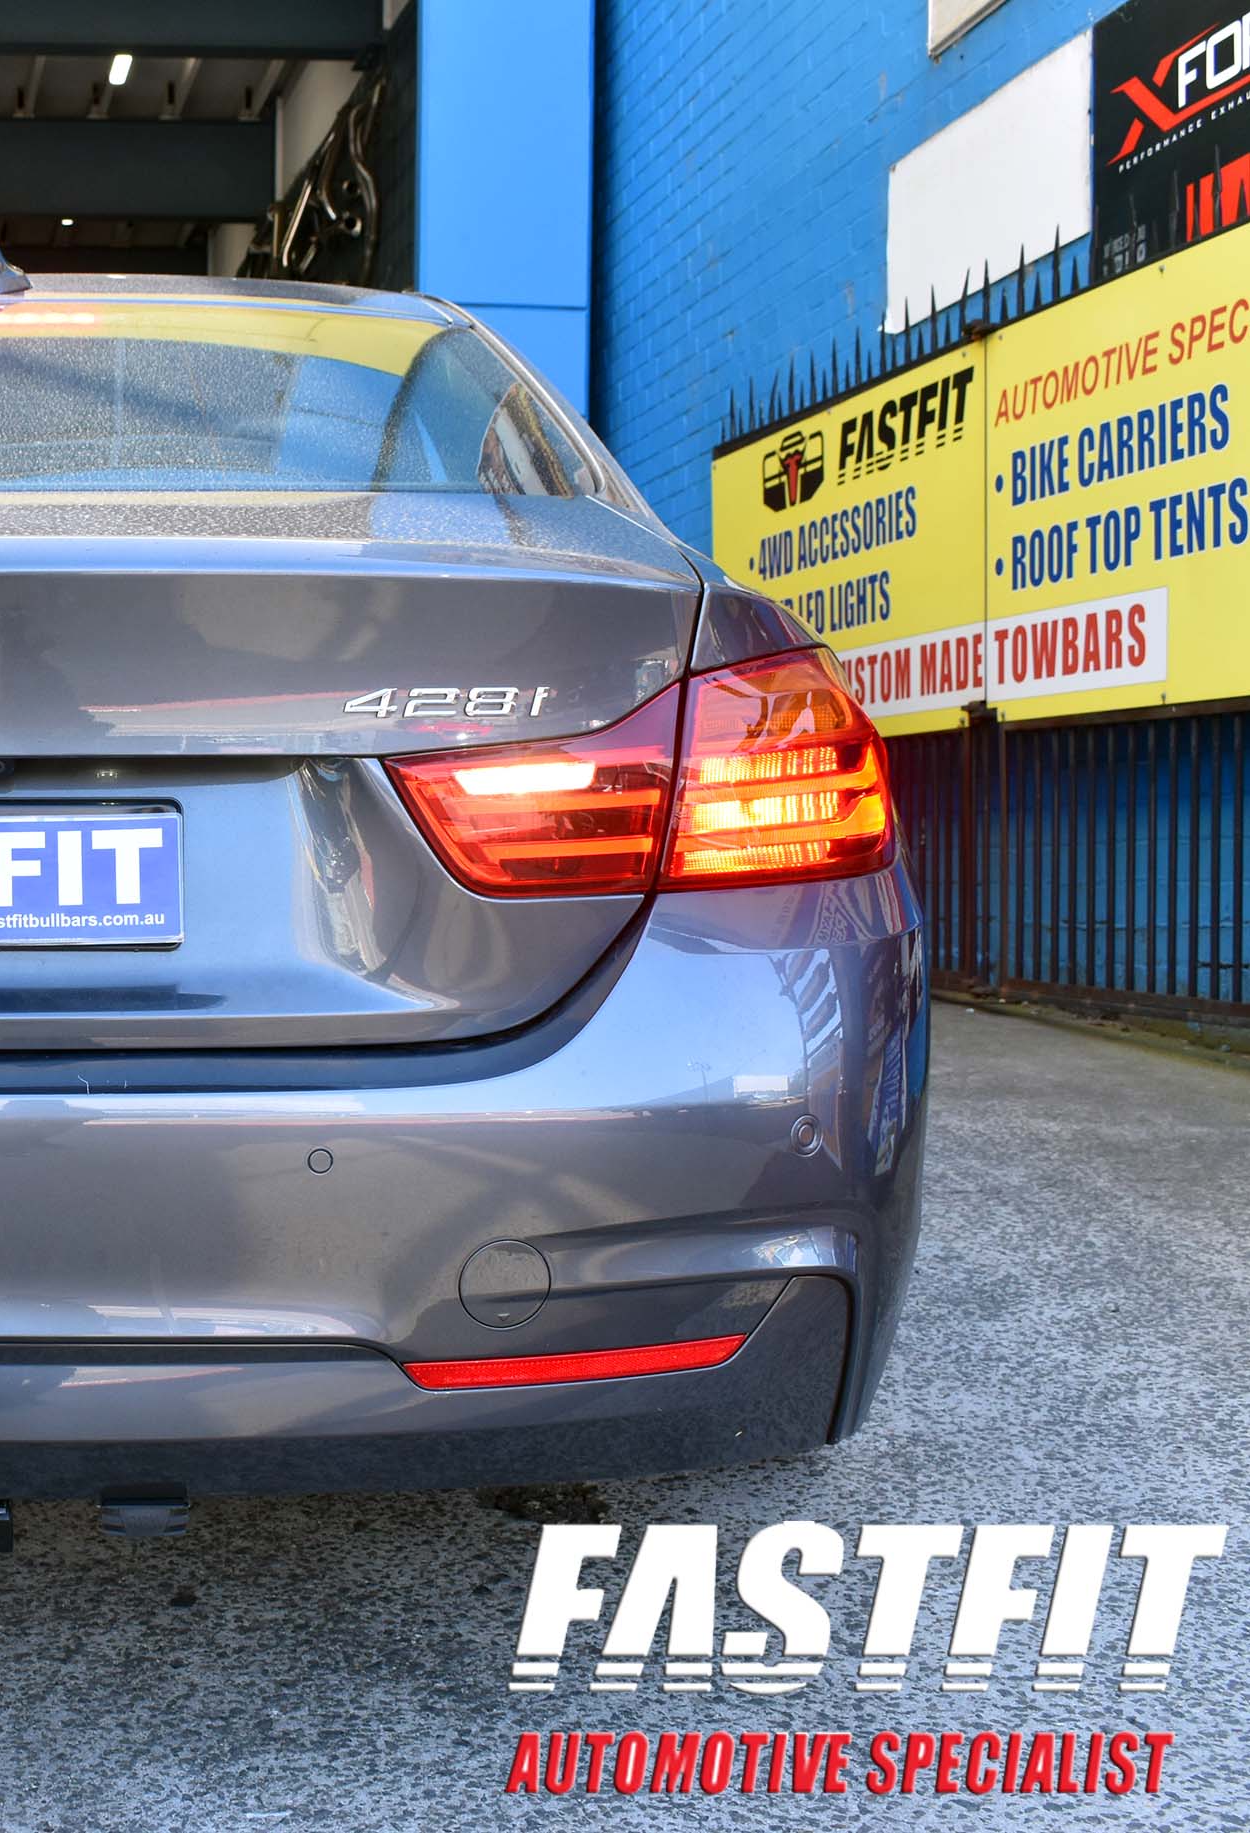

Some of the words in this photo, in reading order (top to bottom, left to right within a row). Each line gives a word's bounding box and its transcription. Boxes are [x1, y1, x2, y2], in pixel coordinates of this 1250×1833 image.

[1118, 118, 1203, 173] PERFORMANCE
[994, 331, 1161, 428] AUTOMOTIVE
[1168, 299, 1250, 366] SPEC
[837, 365, 975, 486] FASTFIT
[1011, 434, 1070, 507] BIKE
[1078, 384, 1230, 488] CARRIERS
[759, 530, 793, 581] 4WD
[798, 486, 917, 570] ACCESSORIES
[1011, 521, 1079, 592] ROOF
[1086, 505, 1141, 575] TOP
[1149, 477, 1249, 561] TENTS
[830, 570, 890, 632] LIGHTS
[920, 633, 983, 697] MADE
[994, 603, 1146, 685] TOWBARS
[343, 686, 551, 718] 428i
